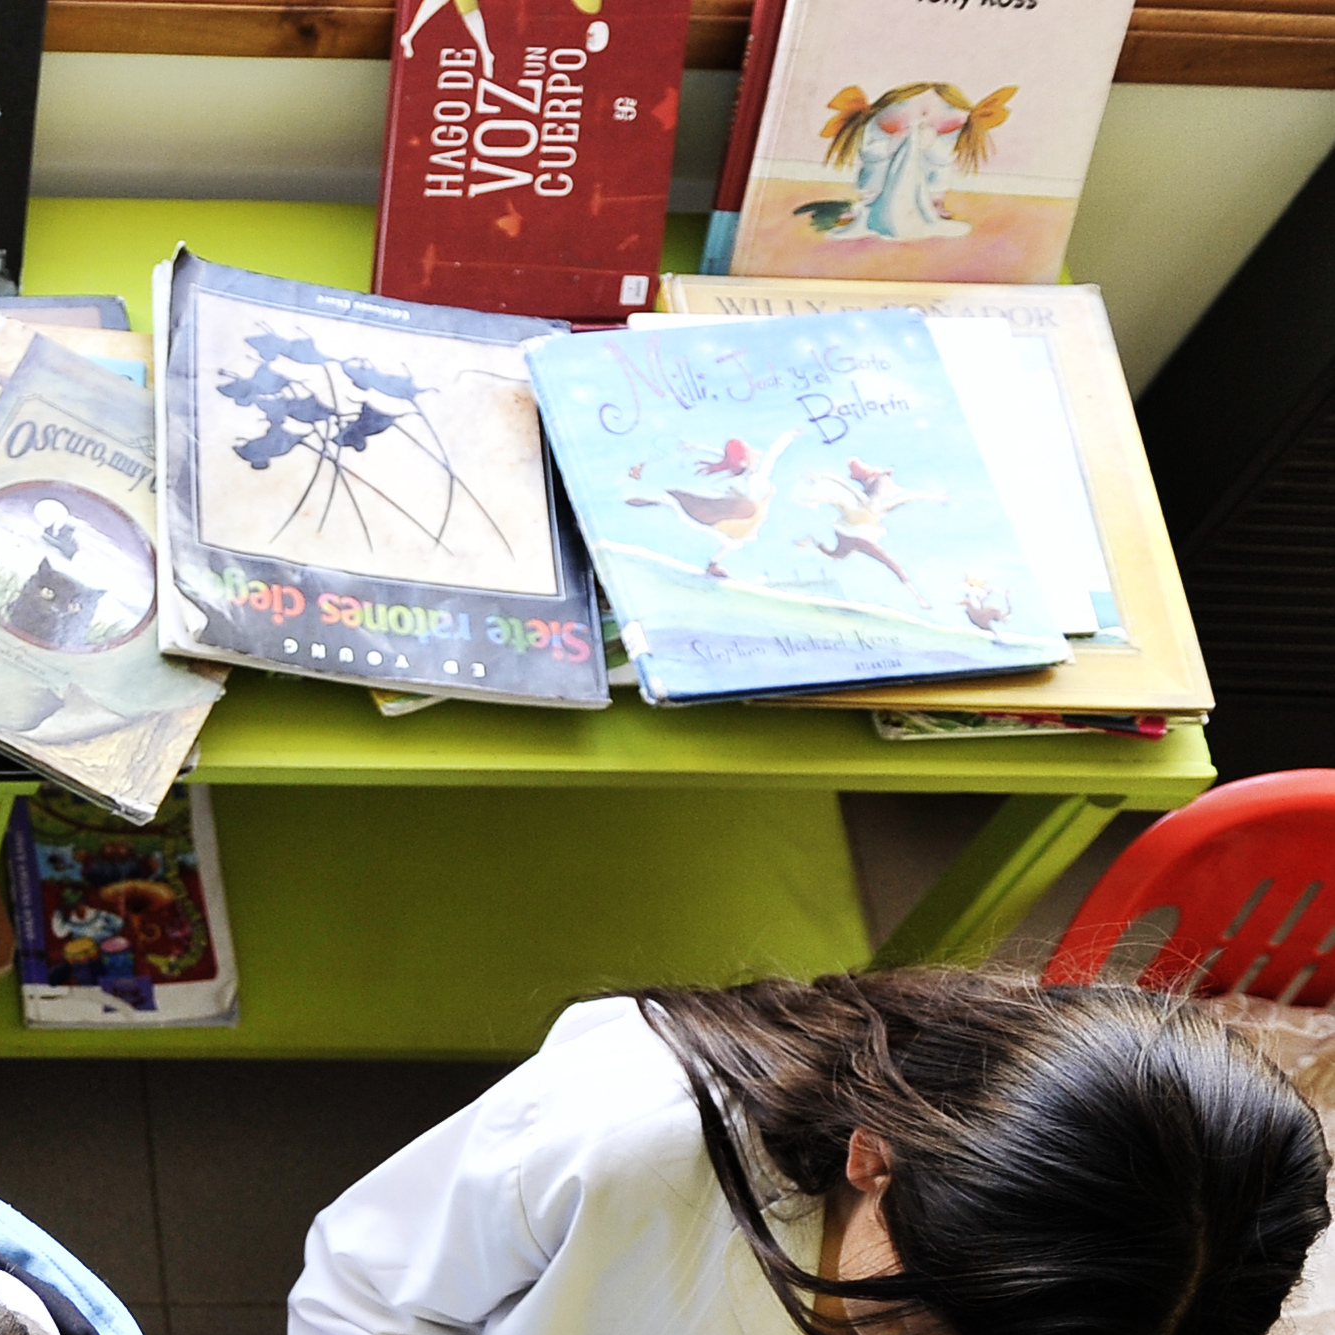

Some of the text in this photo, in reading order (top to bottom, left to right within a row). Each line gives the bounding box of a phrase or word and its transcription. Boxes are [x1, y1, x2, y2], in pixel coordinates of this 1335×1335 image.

[424, 47, 477, 198] HAGO DE
[468, 46, 548, 199] VOZ UN
[534, 47, 588, 198] CUERPO
[283, 637, 486, 678] ED YOUNG
[318, 592, 472, 641] ratones
[487, 614, 592, 663] Siete
